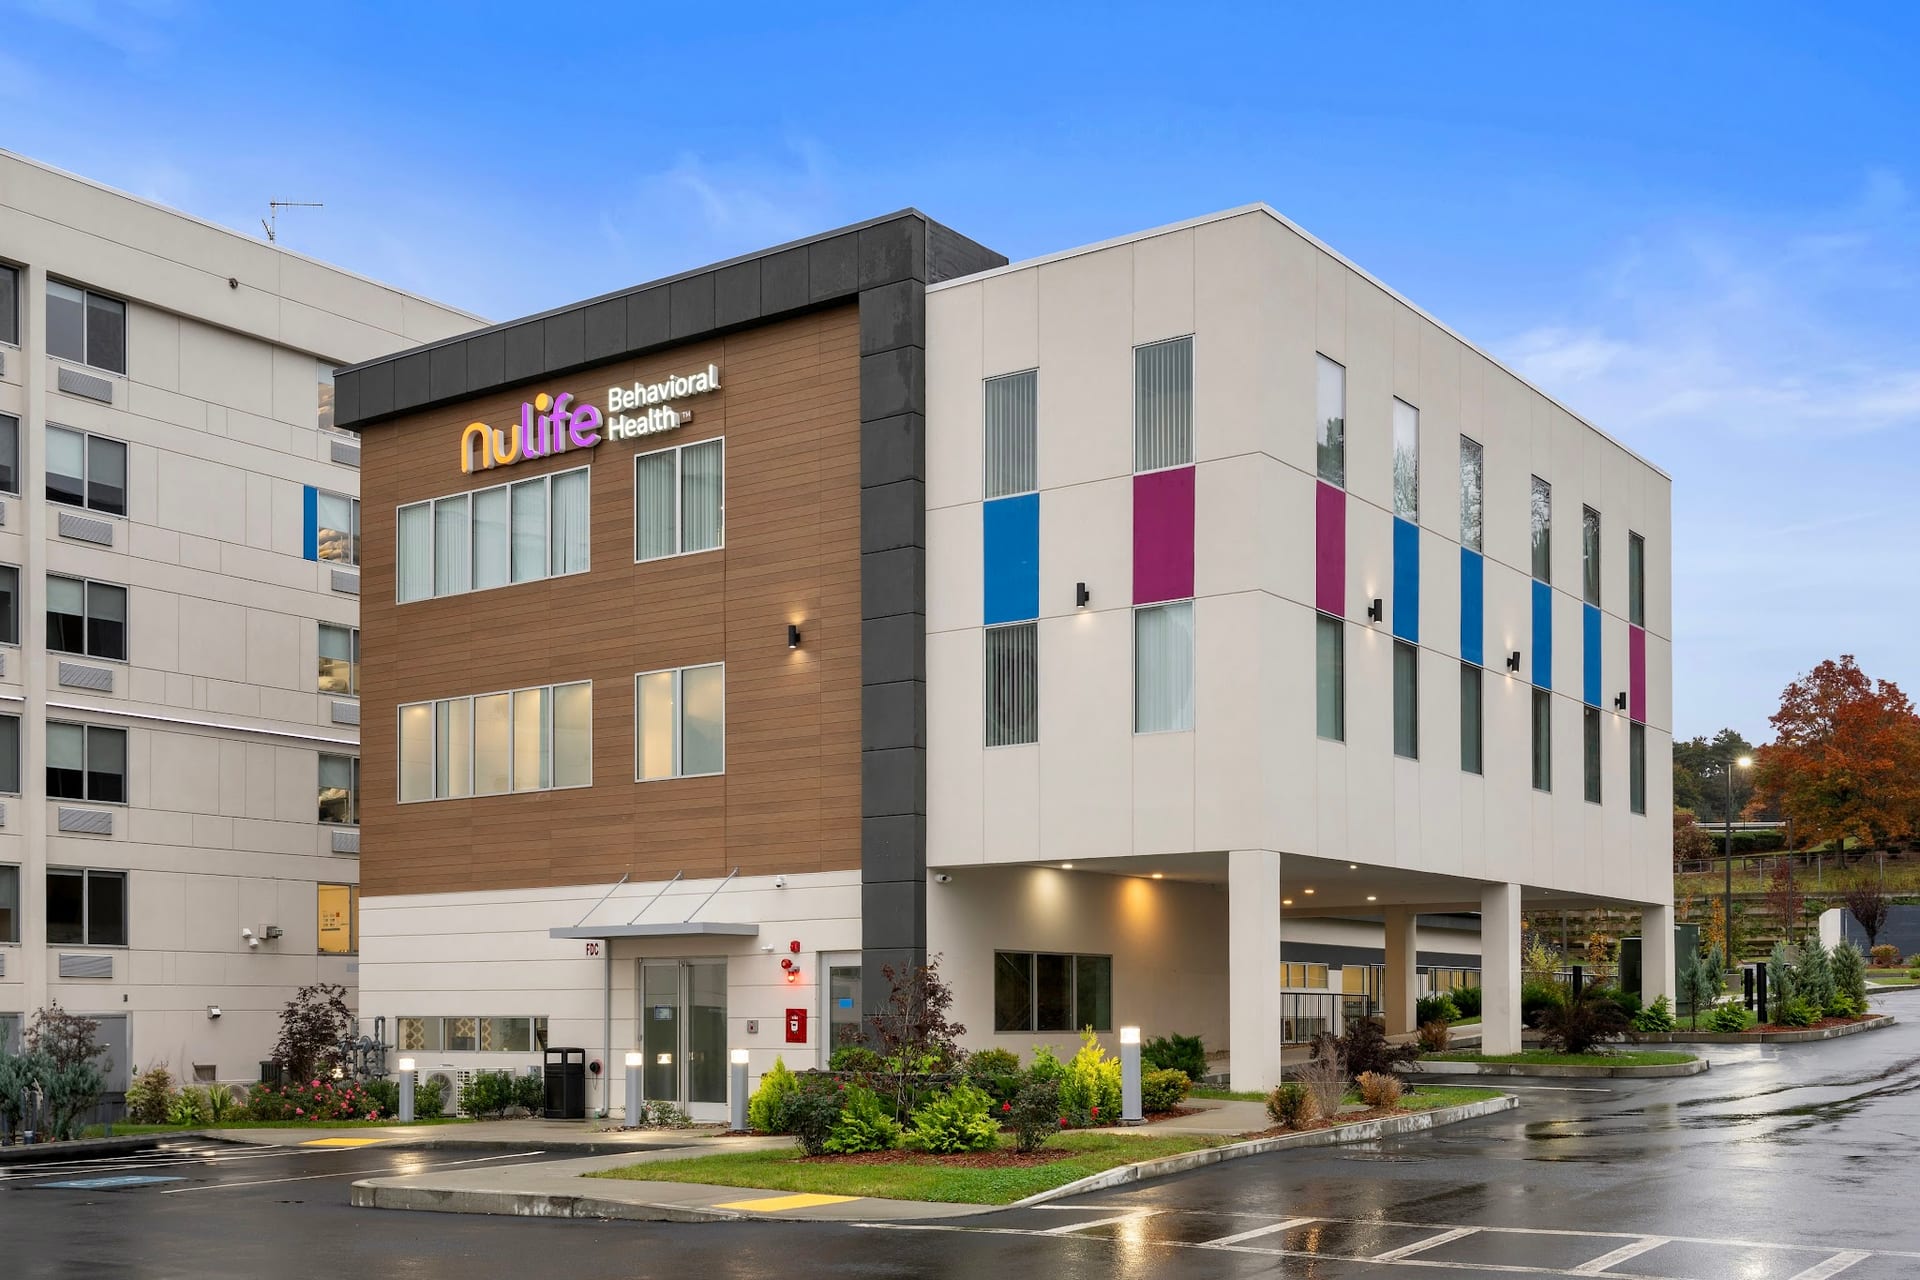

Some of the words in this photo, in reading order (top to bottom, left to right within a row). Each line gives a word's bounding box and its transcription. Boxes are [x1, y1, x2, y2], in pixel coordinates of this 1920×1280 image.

[608, 363, 720, 412] Behavioral
[461, 392, 602, 474] nulife
[608, 405, 679, 441] Health
[586, 942, 599, 956] FDC
